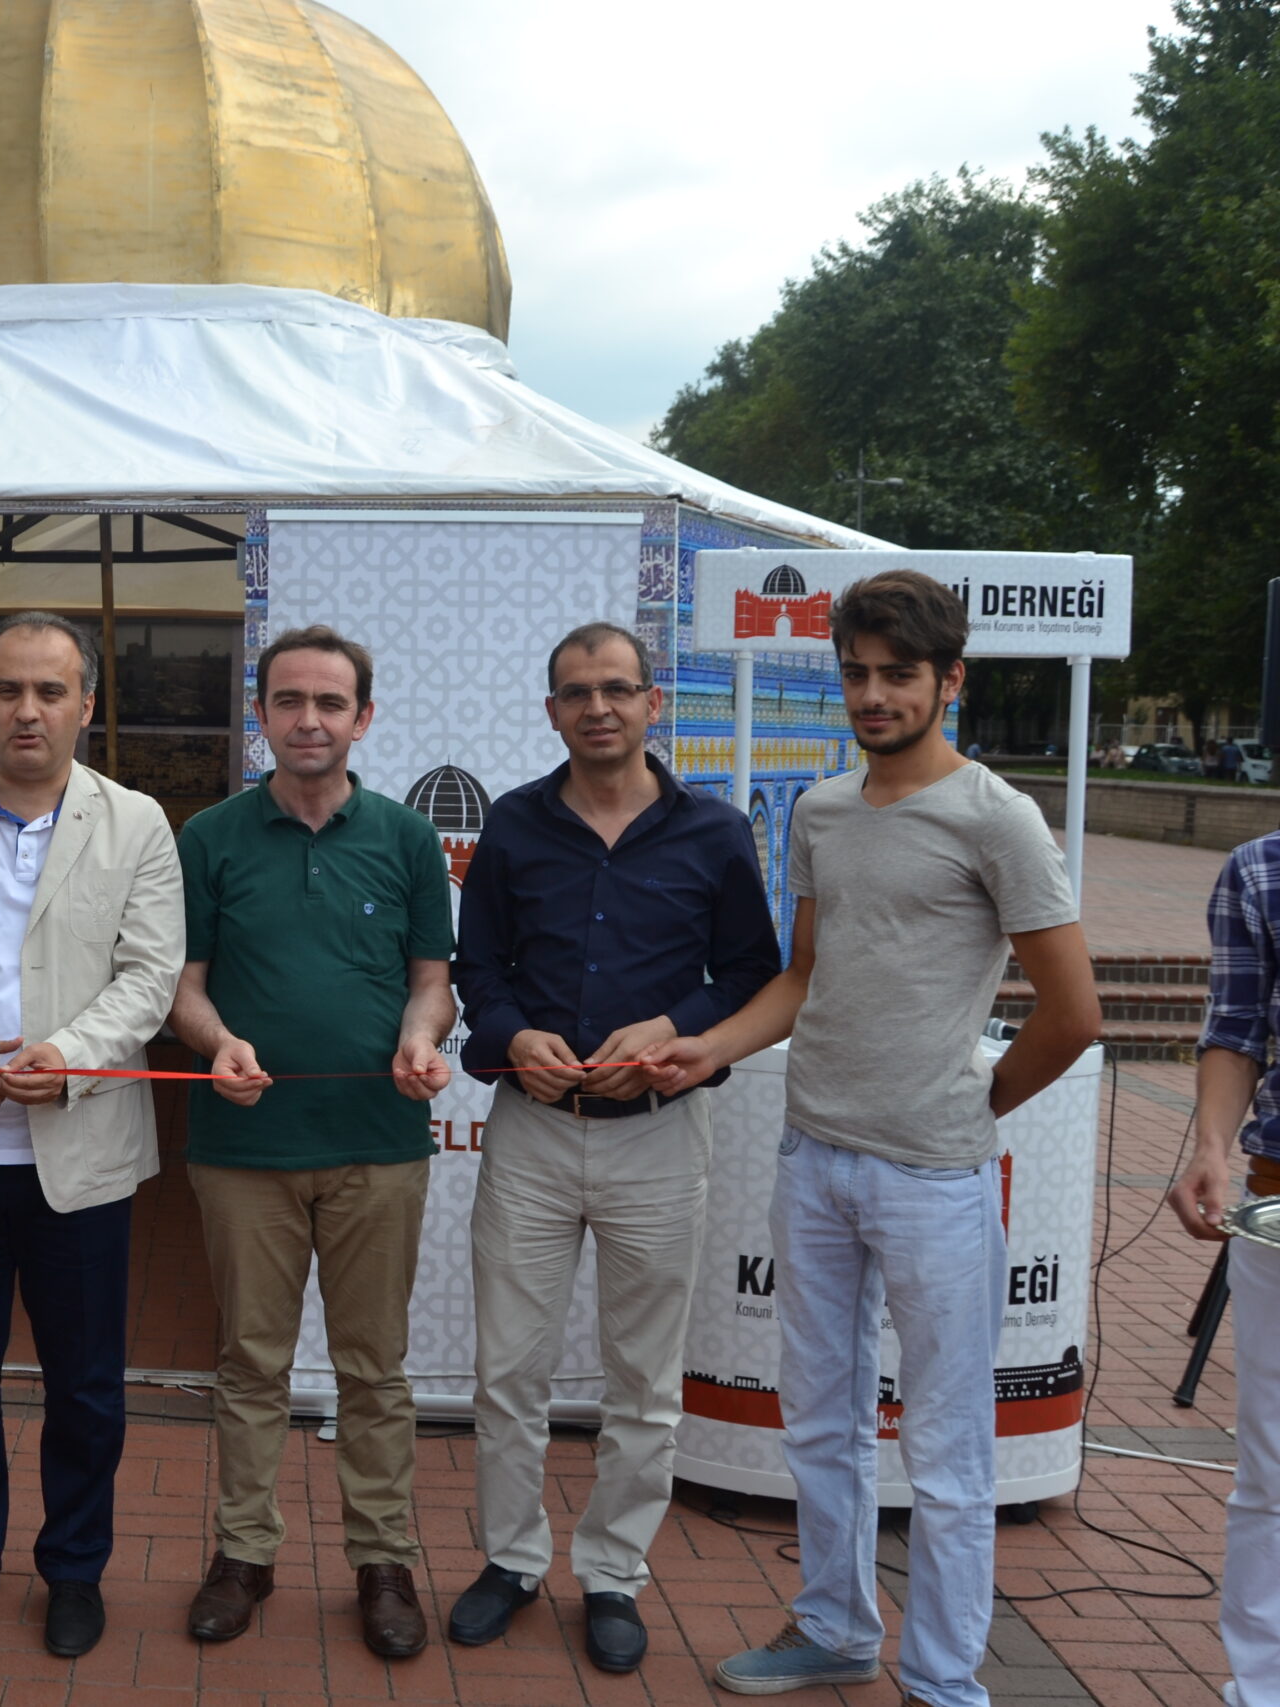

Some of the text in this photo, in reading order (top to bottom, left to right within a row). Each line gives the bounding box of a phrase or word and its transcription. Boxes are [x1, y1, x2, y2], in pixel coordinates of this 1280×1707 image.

[981, 579, 1105, 618] DERNEĞİ
[994, 621, 1024, 633] Koruma
[1026, 623, 1035, 633] ve
[1073, 621, 1102, 636] Derneği
[1008, 1254, 1059, 1306] EĞİ
[736, 1300, 773, 1320] Kanuni
